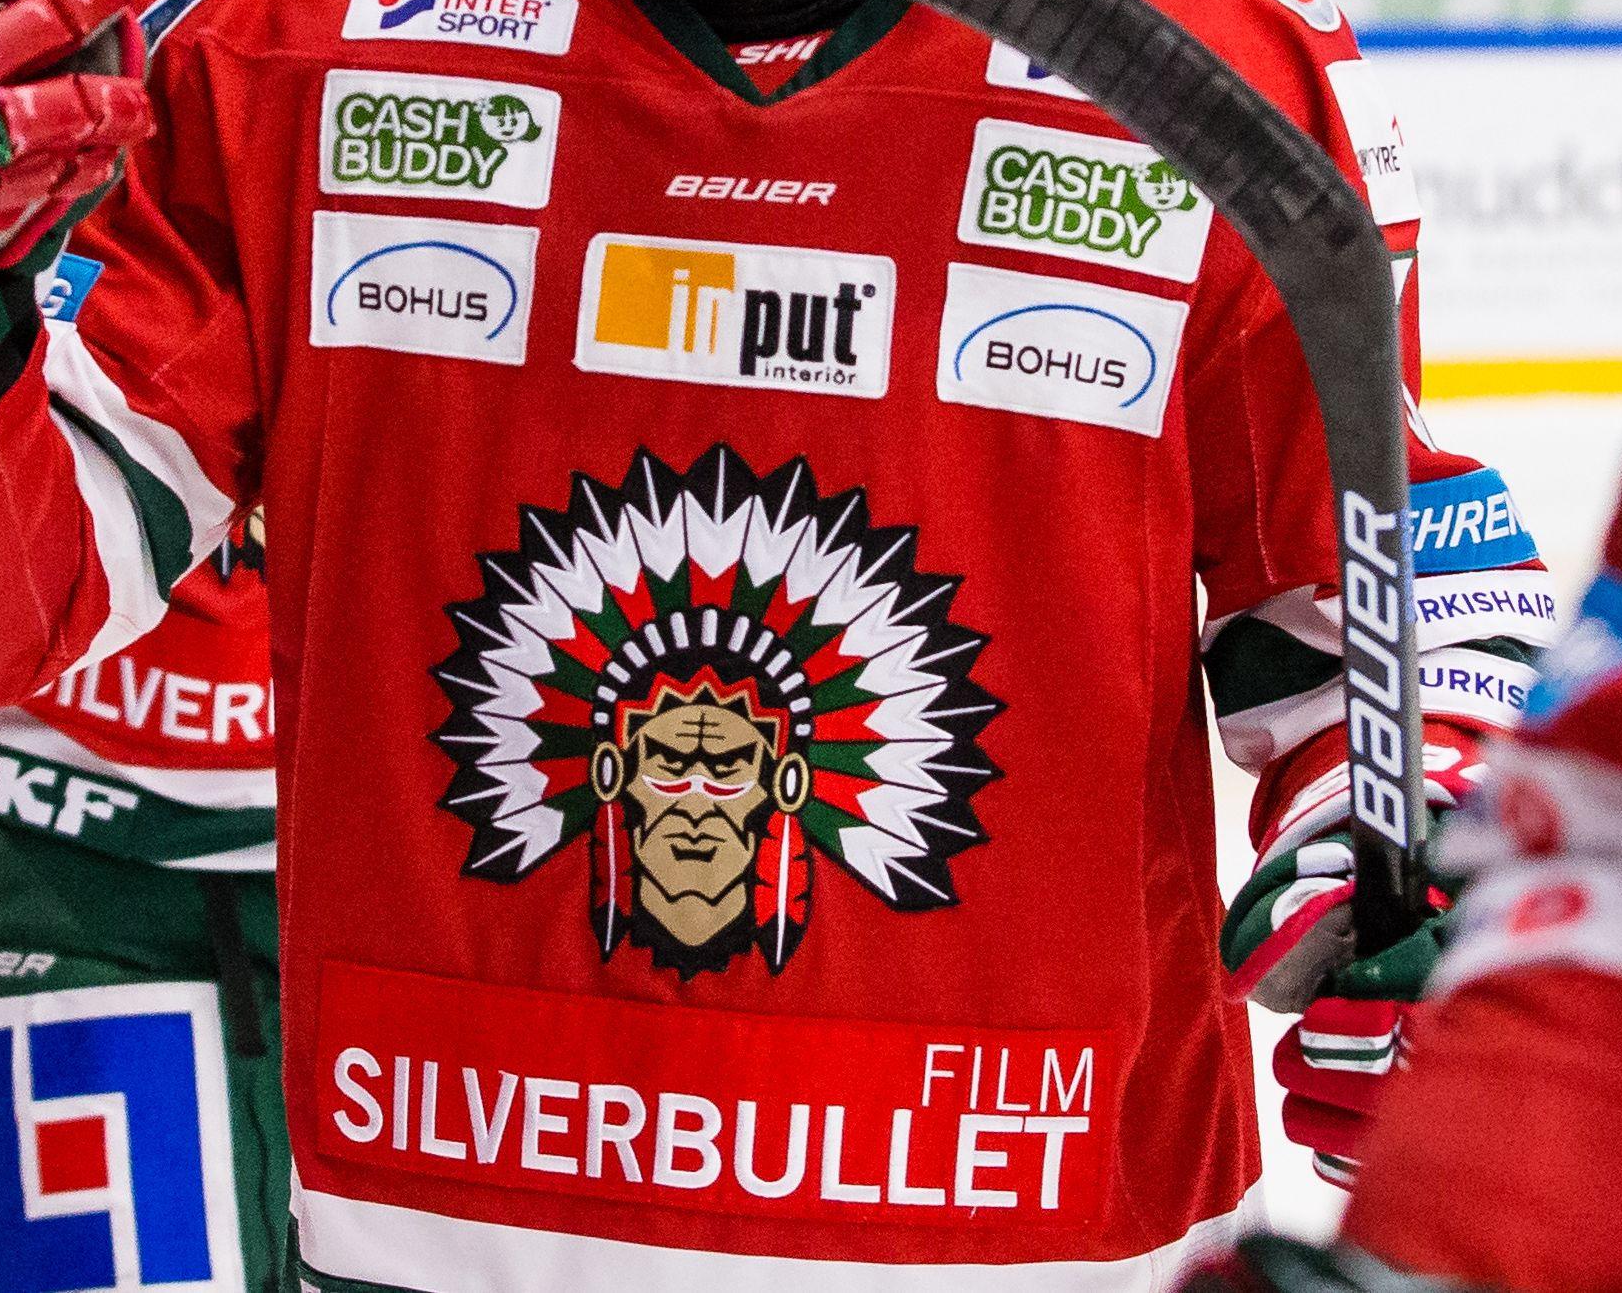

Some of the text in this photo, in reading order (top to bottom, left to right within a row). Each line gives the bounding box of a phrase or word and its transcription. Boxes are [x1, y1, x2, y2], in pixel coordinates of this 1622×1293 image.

[437, 11, 538, 42] SPORT
[341, 97, 467, 144] CASH
[337, 139, 503, 186] BUDDY
[991, 151, 1126, 208] CASH
[666, 175, 837, 206] BAUER
[982, 192, 1157, 256] BUDDY
[358, 282, 489, 322] BOHUS
[986, 340, 1128, 389] BOHUS
[1343, 490, 1408, 848] BAUER
[922, 1043, 1095, 1112] FILM
[332, 1046, 1091, 1211] SILVERBULLET
